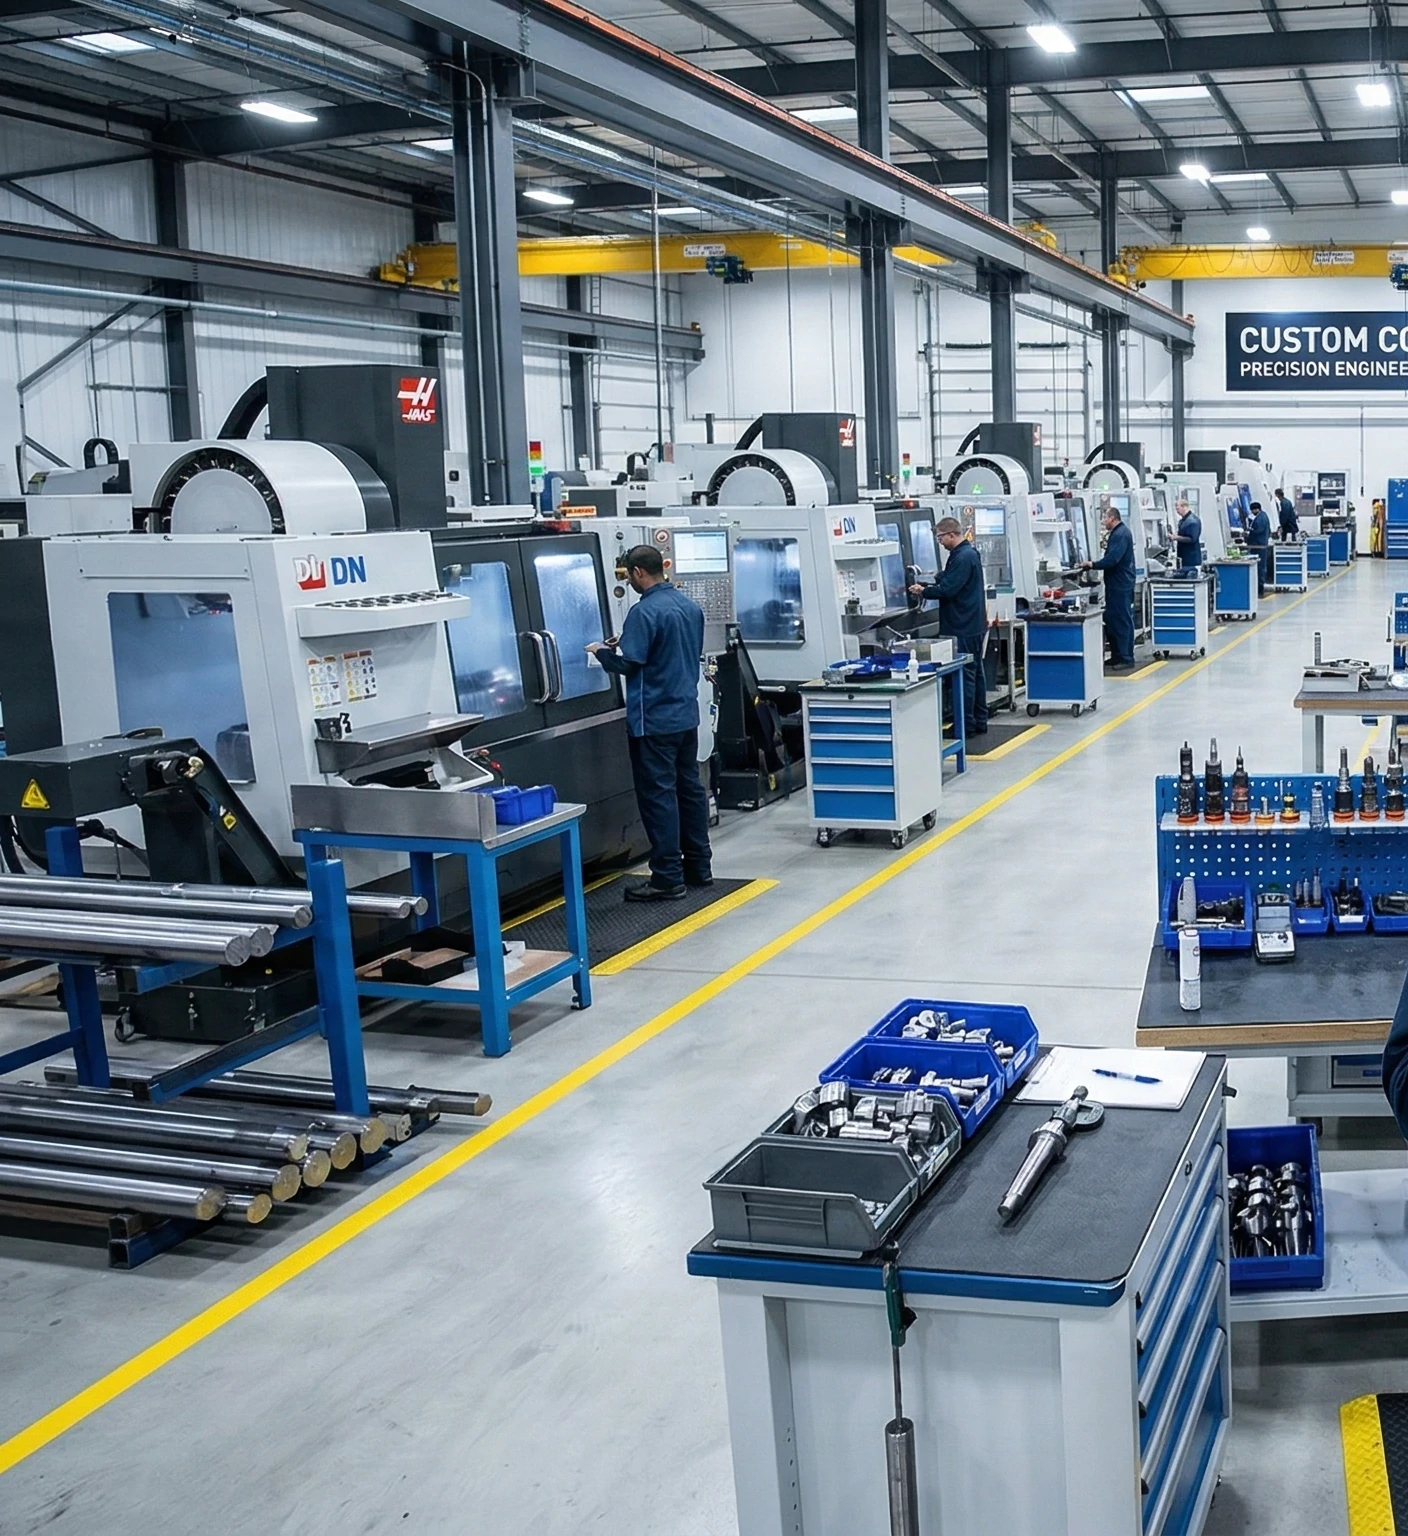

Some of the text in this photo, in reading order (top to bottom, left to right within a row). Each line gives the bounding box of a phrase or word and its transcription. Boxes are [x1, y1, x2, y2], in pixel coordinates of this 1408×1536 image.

[1240, 326, 1368, 353] CUSTOM
[1240, 361, 1330, 377] PRECISION
[330, 555, 367, 585] DN
